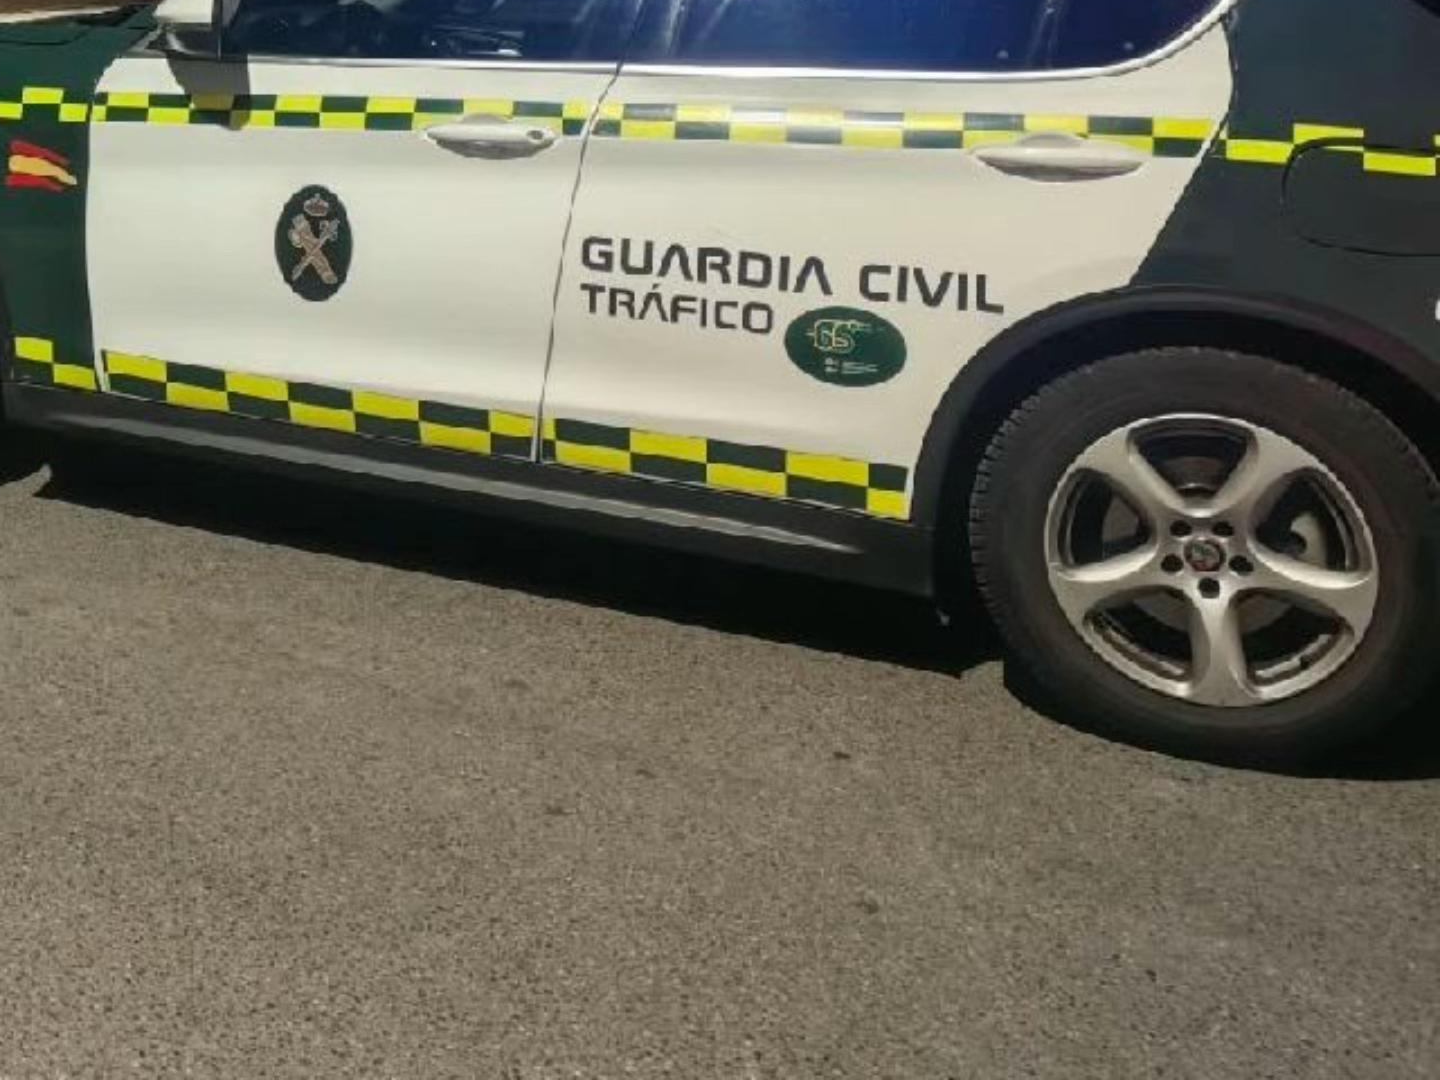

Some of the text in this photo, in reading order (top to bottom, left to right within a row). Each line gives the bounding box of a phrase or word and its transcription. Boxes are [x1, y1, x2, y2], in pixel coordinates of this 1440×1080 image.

[581, 235, 1005, 314] GUARDIA CIVIL
[580, 283, 774, 334] TRÁFICO
